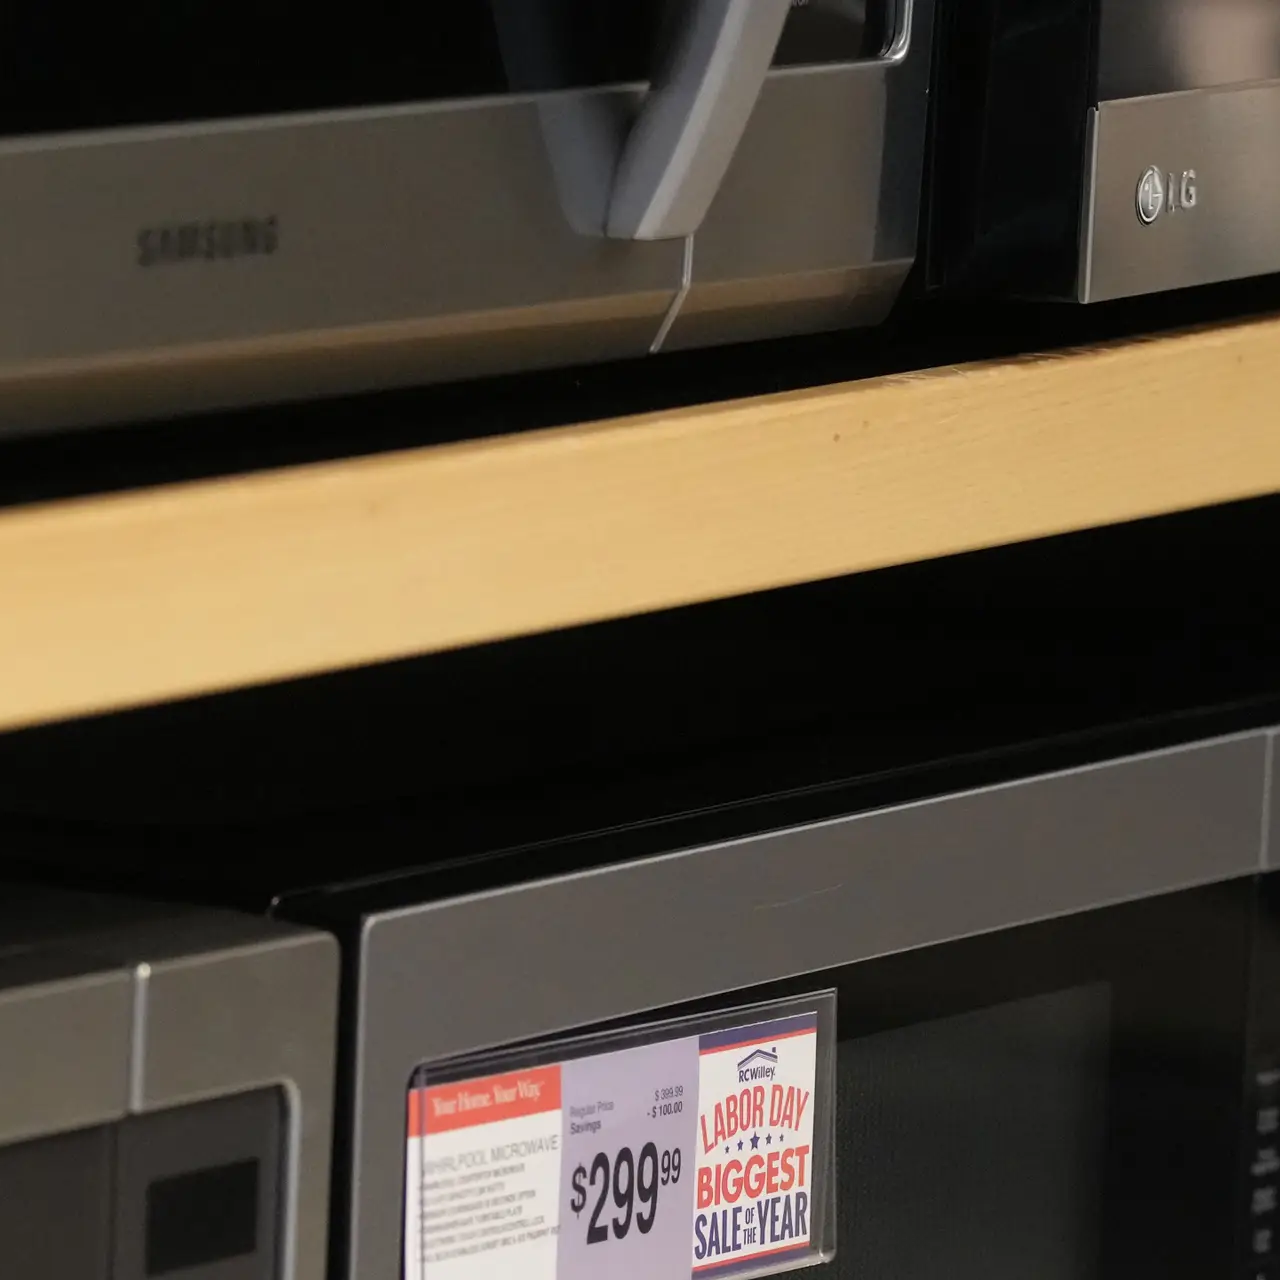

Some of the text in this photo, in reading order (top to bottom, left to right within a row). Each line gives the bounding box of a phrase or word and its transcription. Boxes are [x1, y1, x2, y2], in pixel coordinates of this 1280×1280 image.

[660, 1085, 684, 1101] 399.99
[658, 1100, 683, 1116] 100.00
[700, 1084, 810, 1155] LABOR DAY
[570, 1119, 602, 1135] Savings
[490, 1134, 560, 1162] MICROWAVE
[696, 1144, 810, 1210] BIGGEST
[694, 1191, 809, 1260] SALE OF YEAR
[742, 1226, 757, 1246] THE
